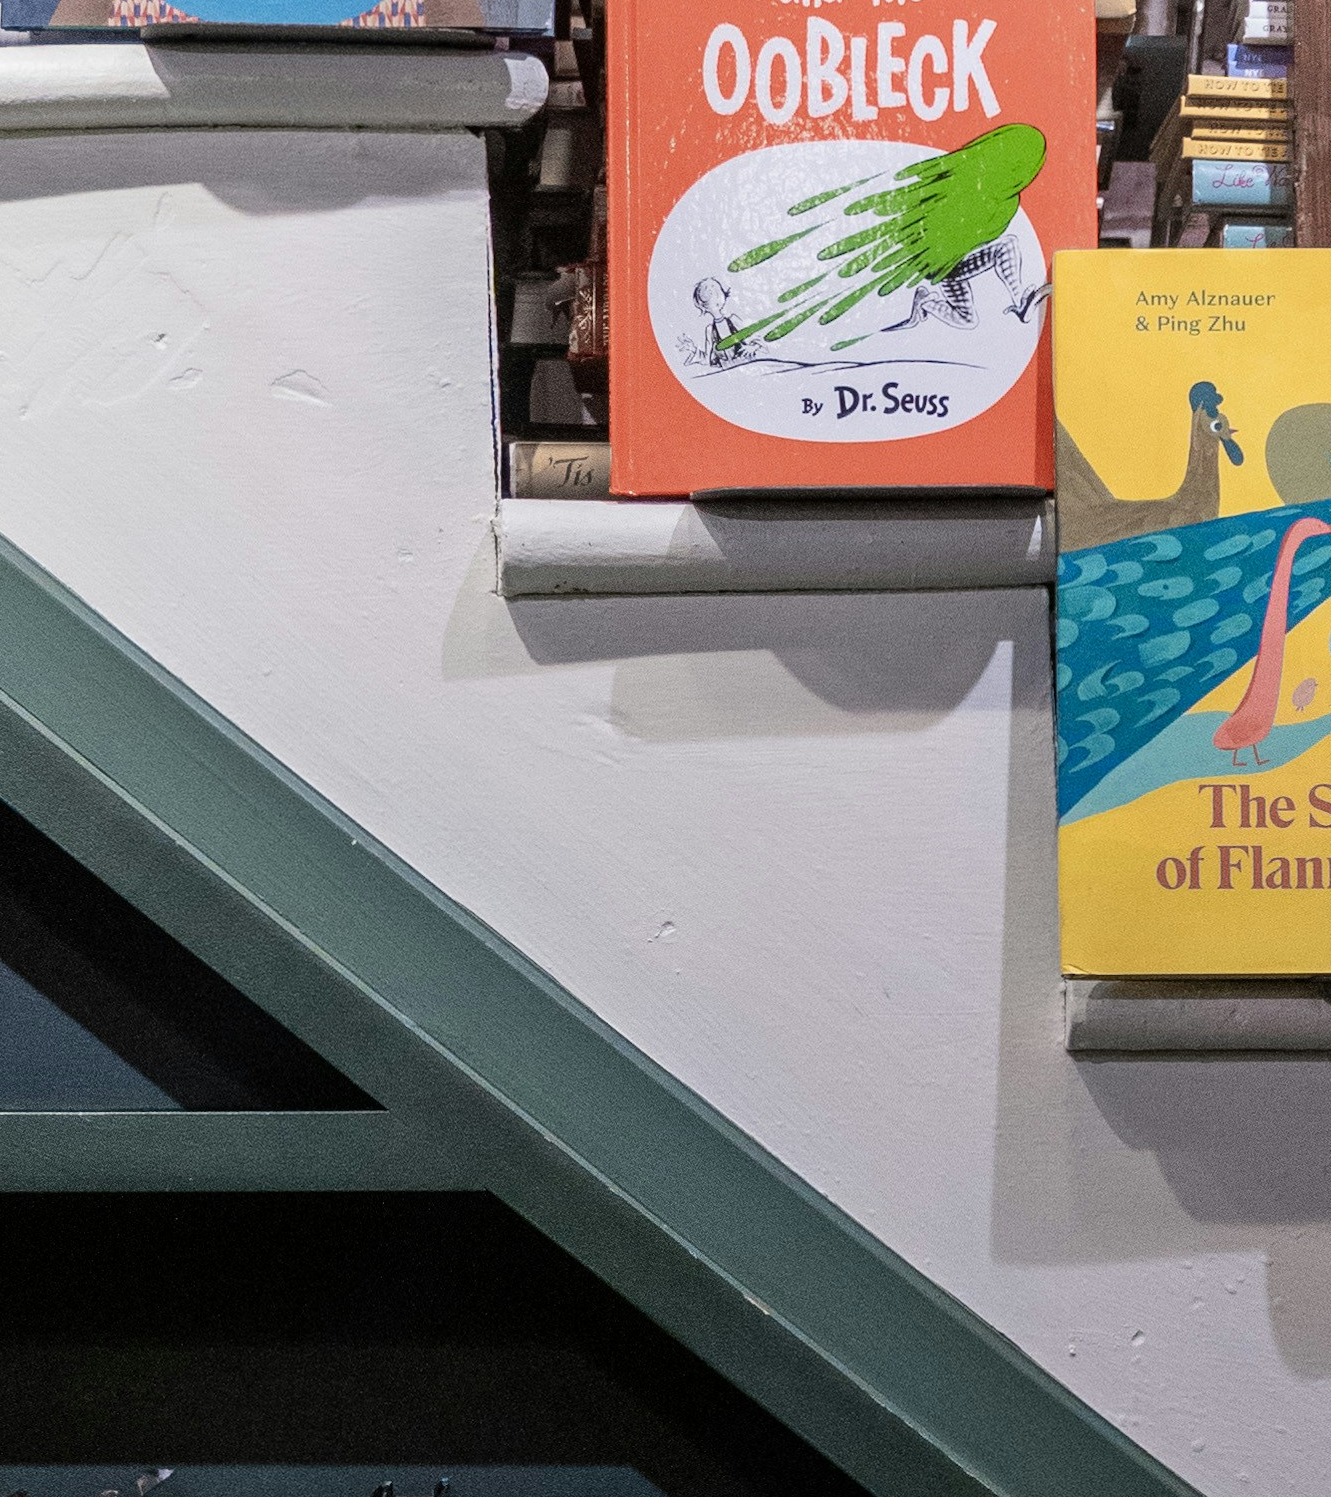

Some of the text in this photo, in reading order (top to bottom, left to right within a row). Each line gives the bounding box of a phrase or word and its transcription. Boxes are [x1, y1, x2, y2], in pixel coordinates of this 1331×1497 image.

[702, 17, 1001, 124] OOBLECK
[1135, 289, 1276, 310] Amy Alznauer
[1136, 315, 1246, 337] & Ping Zhu
[802, 381, 950, 418] By Dr. Seuss
[1199, 784, 1295, 829] The
[1156, 845, 1203, 891] of
